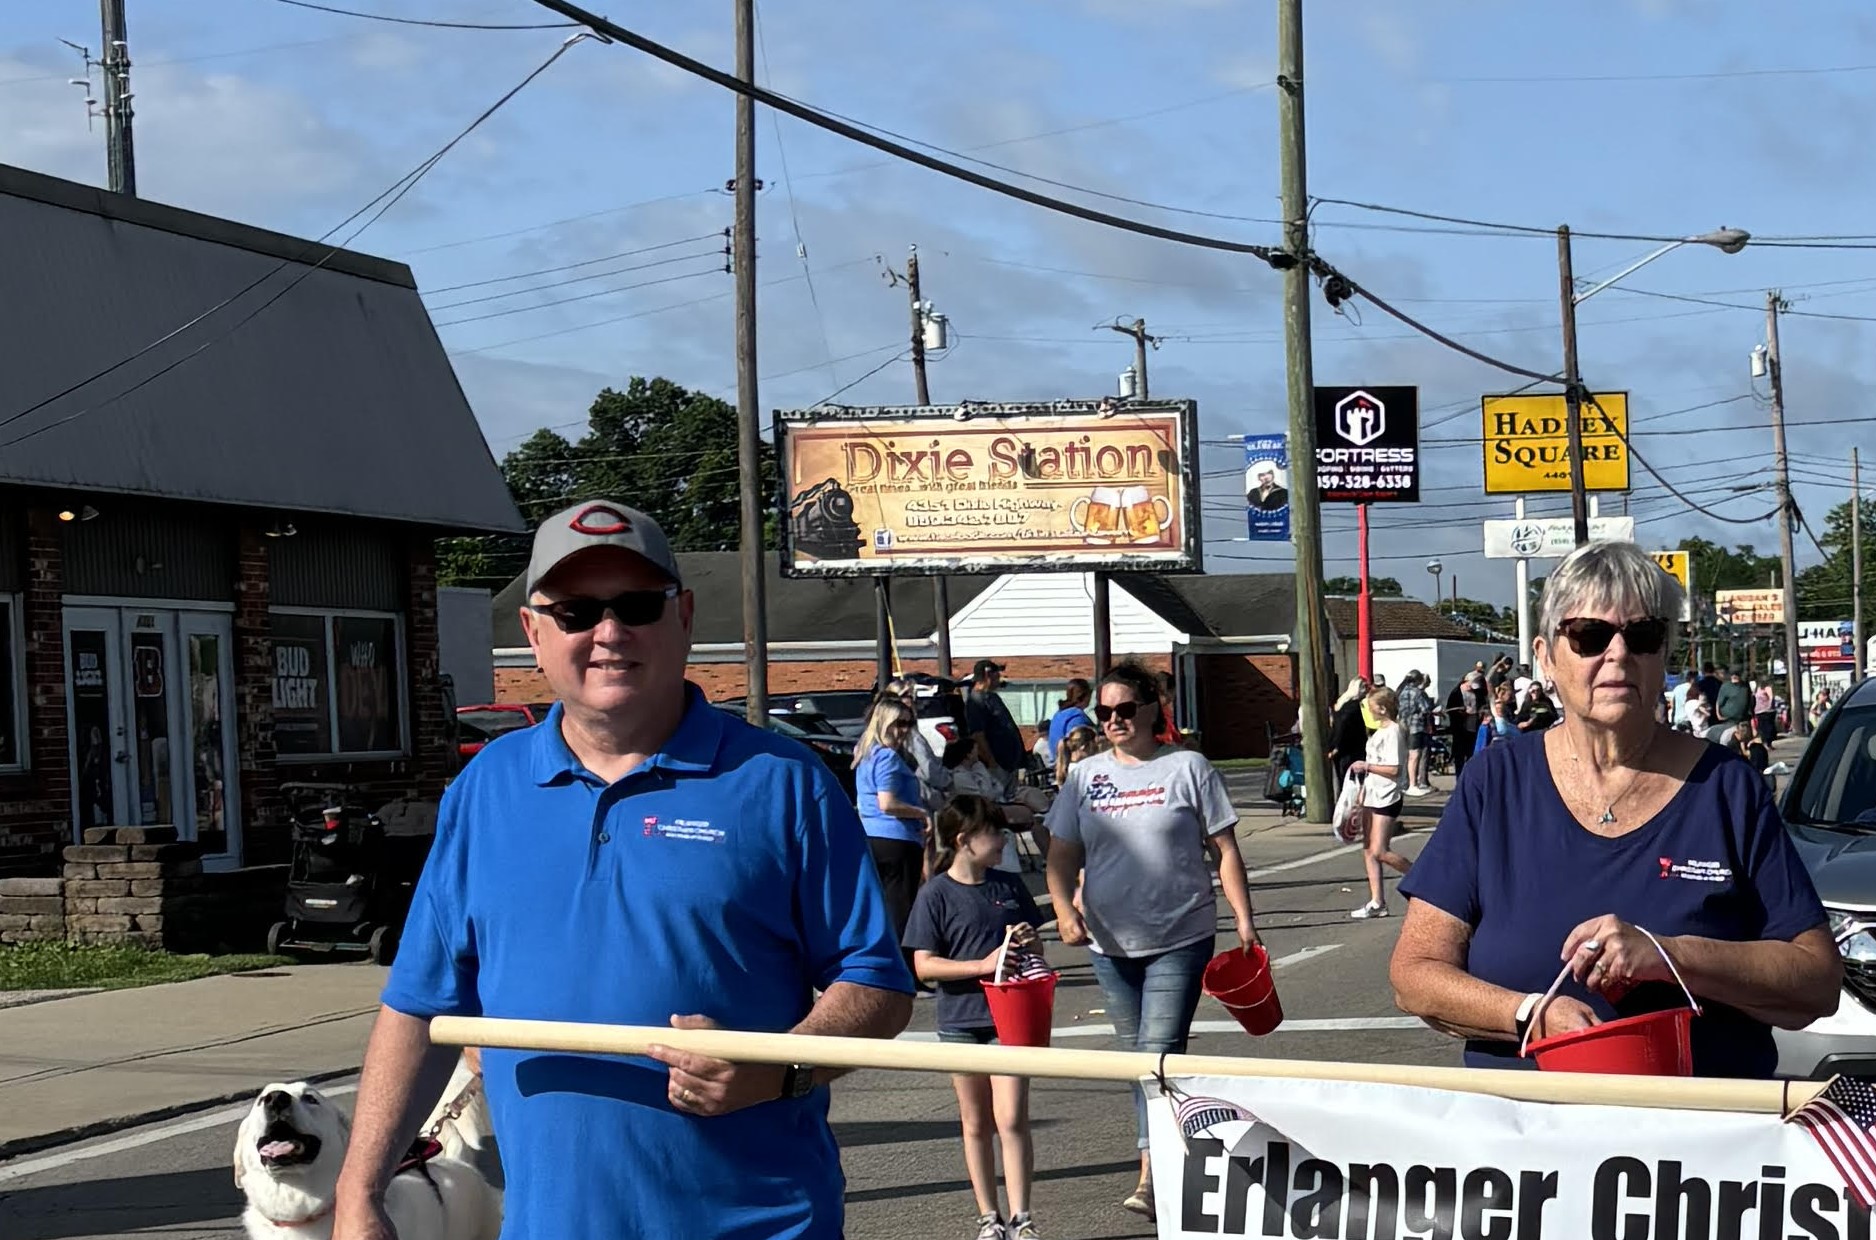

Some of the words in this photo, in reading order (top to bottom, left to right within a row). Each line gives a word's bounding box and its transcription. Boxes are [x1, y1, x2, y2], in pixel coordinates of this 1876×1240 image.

[842, 439, 974, 483] Dixie
[989, 436, 1156, 481] Station
[276, 646, 310, 677] BUD
[272, 678, 318, 709] LIGHT
